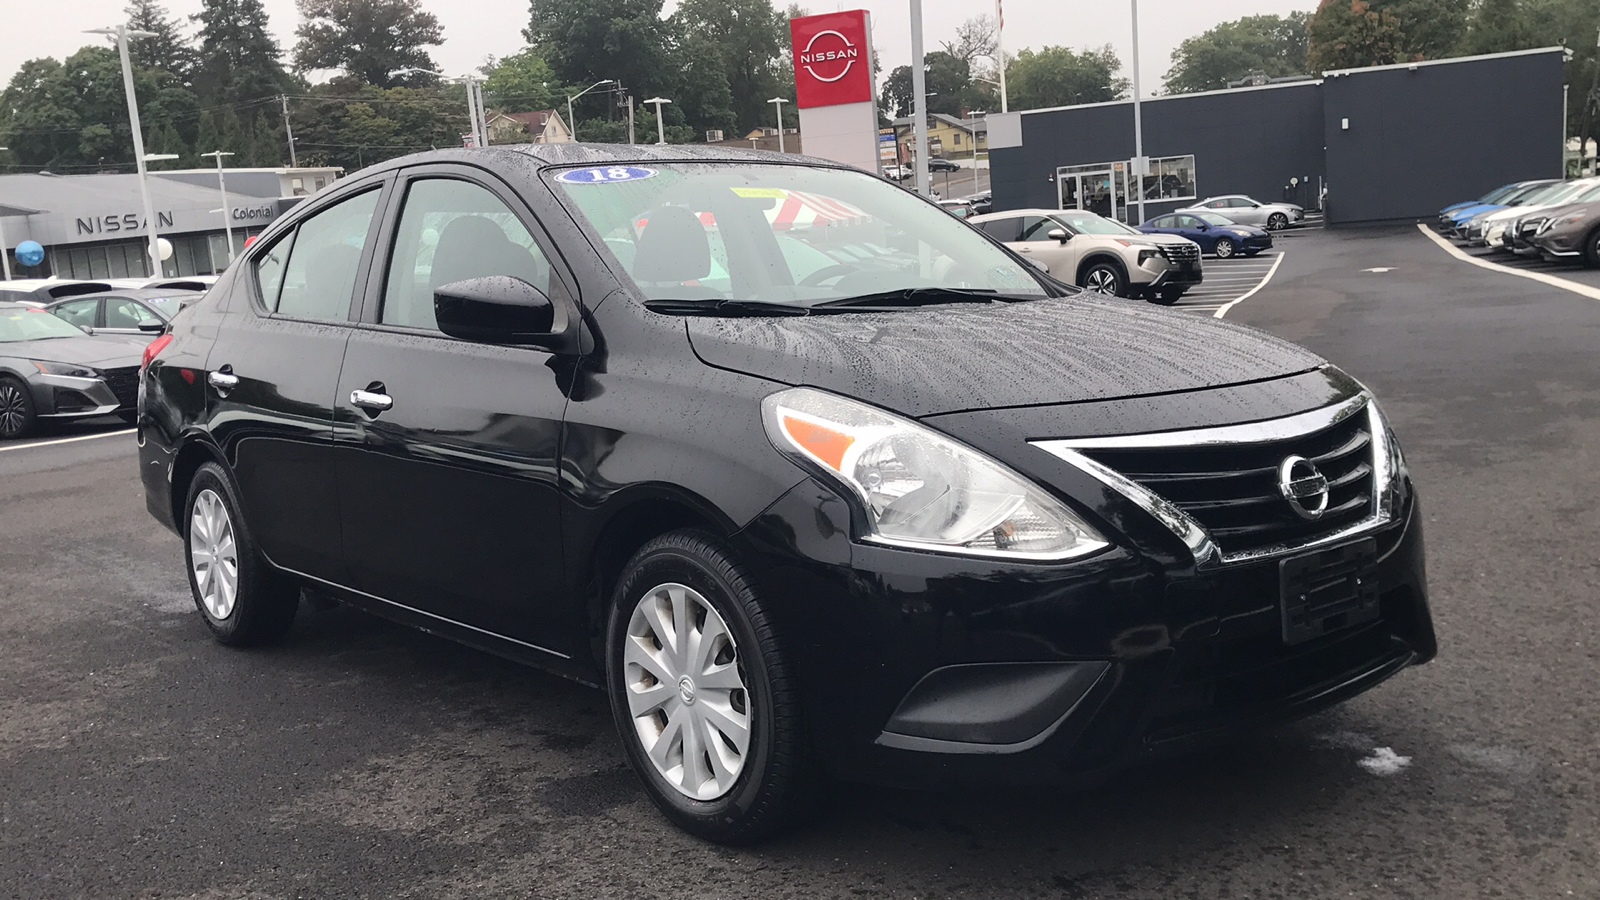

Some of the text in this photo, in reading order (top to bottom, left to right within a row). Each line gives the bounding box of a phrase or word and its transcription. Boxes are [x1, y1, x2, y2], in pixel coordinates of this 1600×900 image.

[801, 48, 857, 63] NISSAN
[588, 168, 630, 181] 18
[232, 205, 274, 220] Colonial
[76, 211, 175, 235] NISSN
